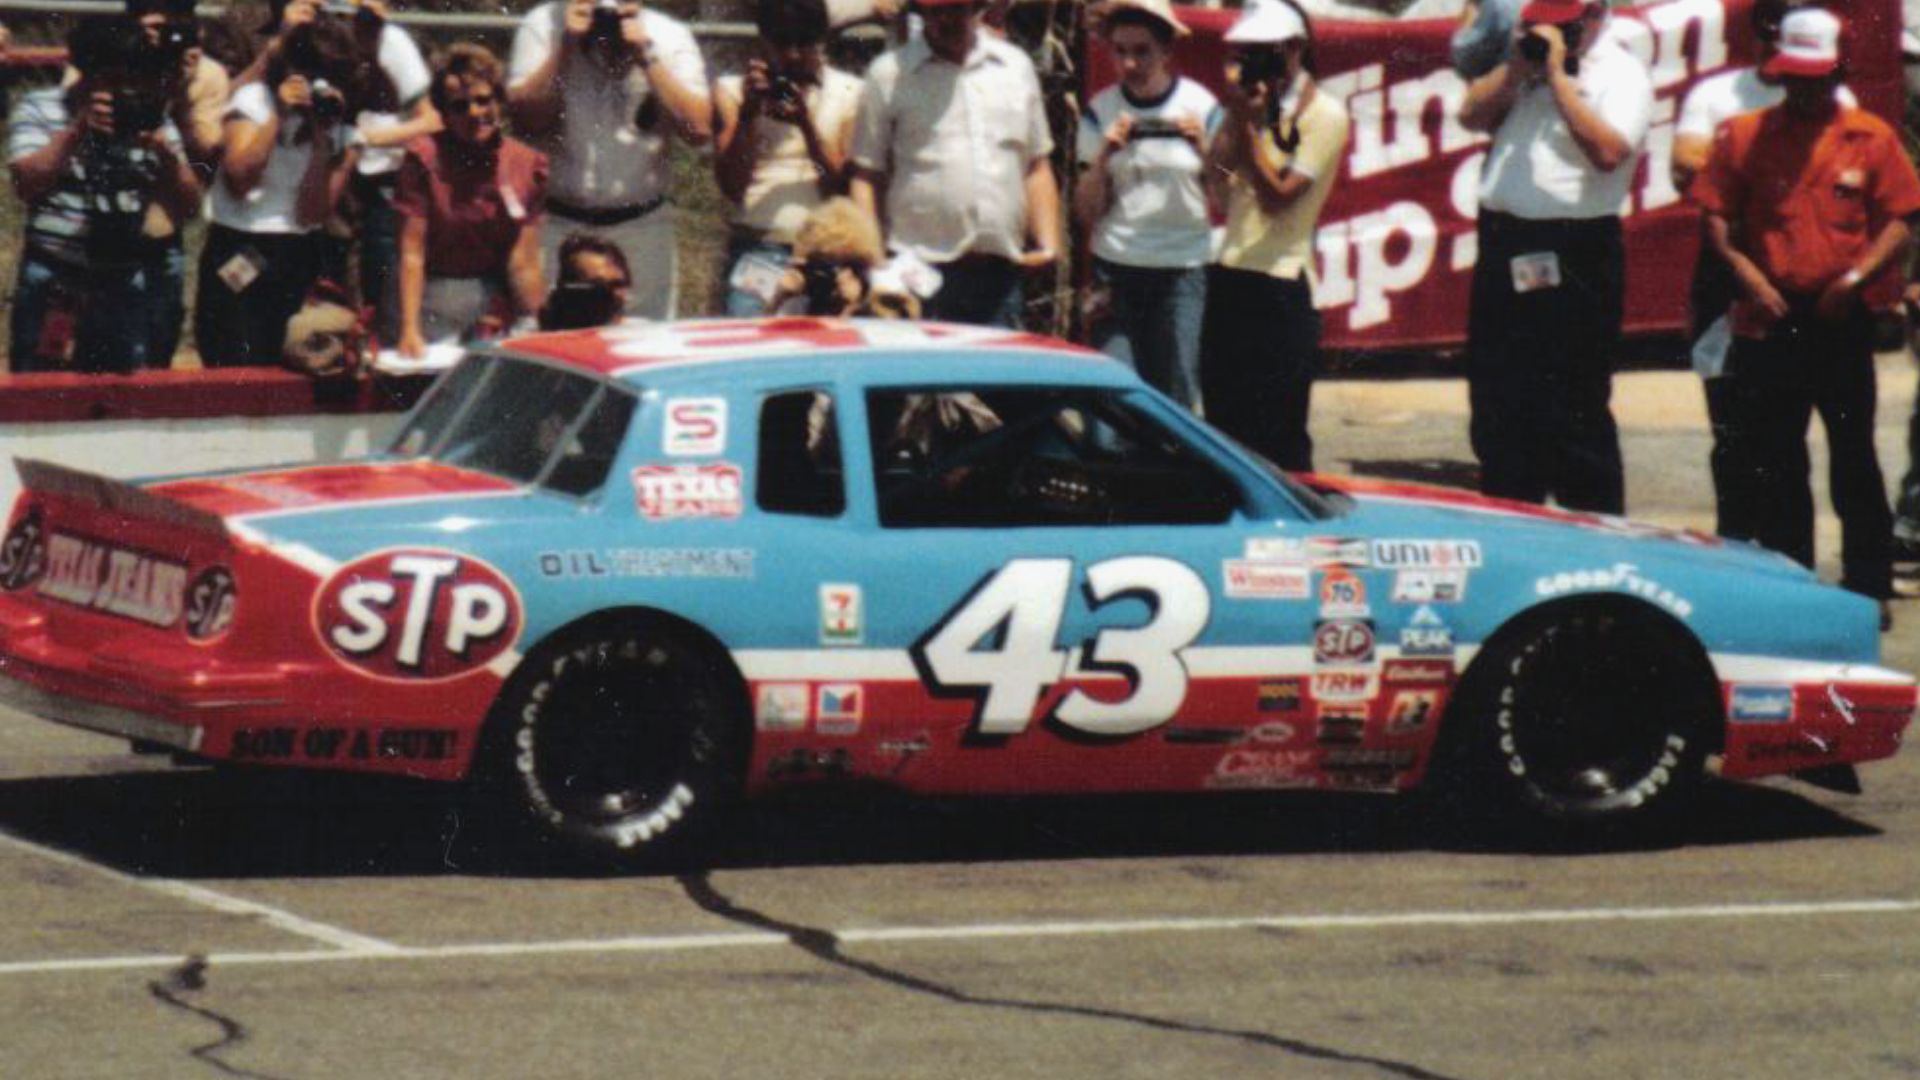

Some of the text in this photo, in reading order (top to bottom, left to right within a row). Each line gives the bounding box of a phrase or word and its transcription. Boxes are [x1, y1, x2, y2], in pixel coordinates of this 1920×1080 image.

[636, 472, 741, 500] TEXAS
[541, 554, 604, 576] OIL
[332, 556, 507, 667] STP
[910, 557, 1210, 745] 43
[1319, 624, 1368, 657] STP
[1403, 628, 1450, 649] PEAK
[1315, 673, 1369, 692] TRW
